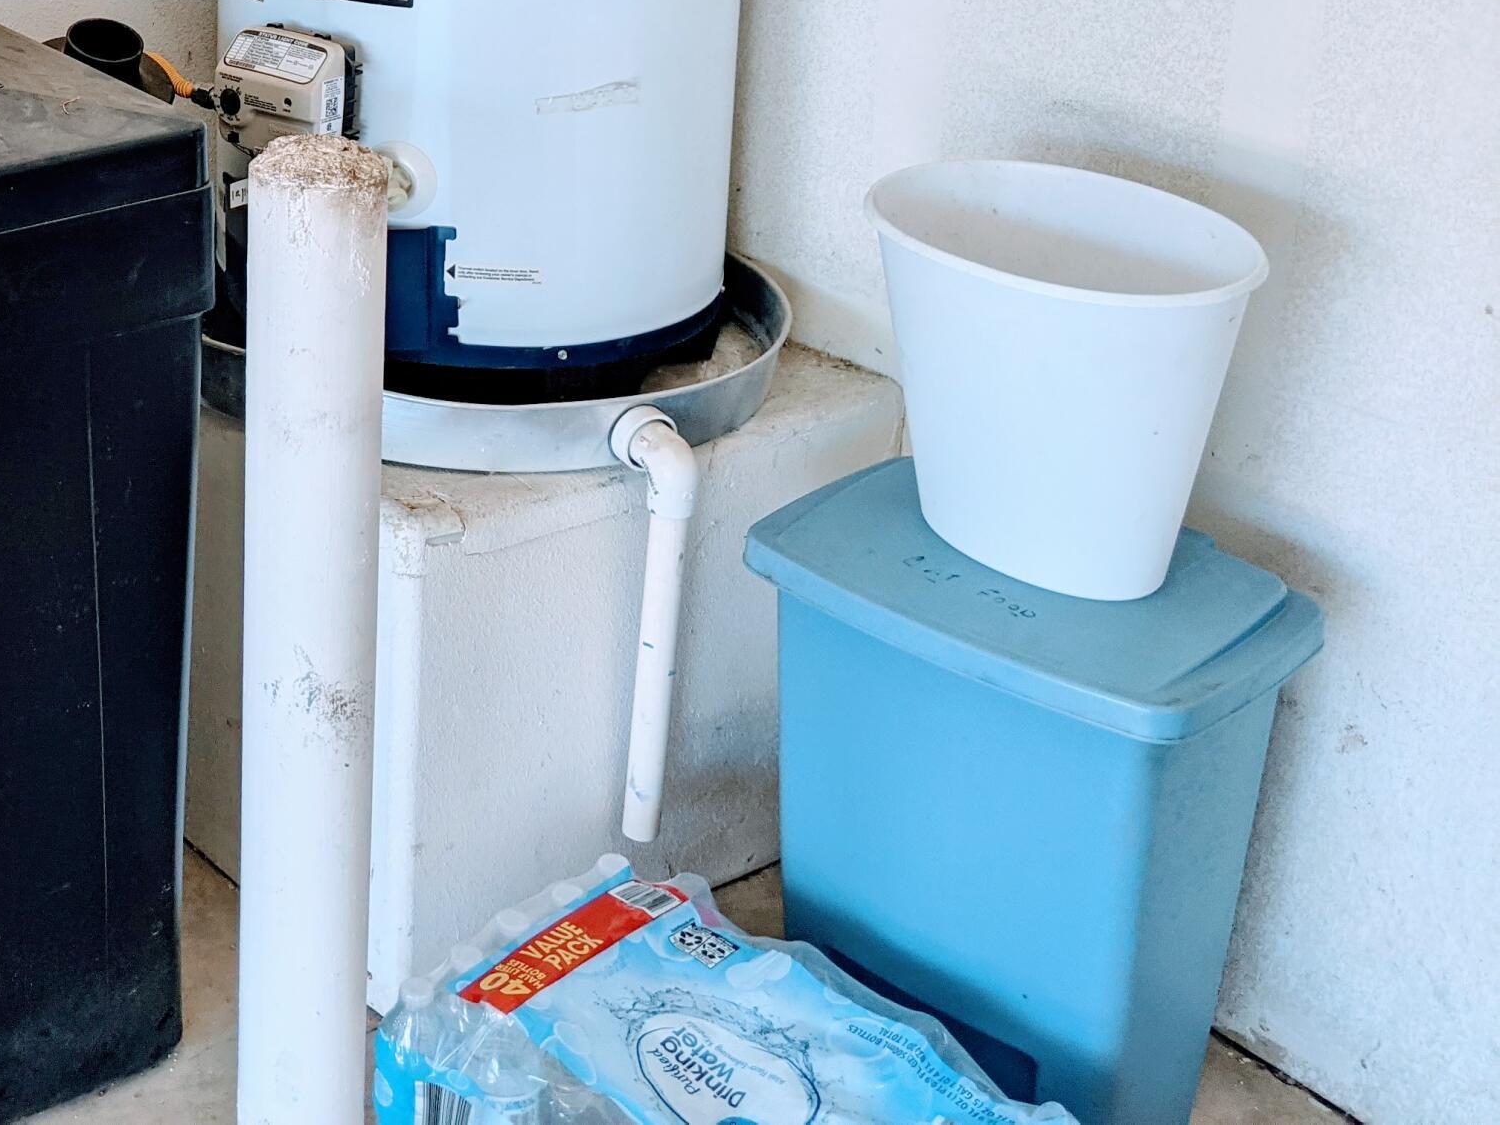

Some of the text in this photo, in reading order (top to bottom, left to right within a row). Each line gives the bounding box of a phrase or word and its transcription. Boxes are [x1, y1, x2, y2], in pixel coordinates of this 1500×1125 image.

[518, 921, 584, 959] VALUE
[542, 933, 605, 971] PACK
[479, 972, 532, 995] 40
[506, 958, 547, 981] BOTTLES
[518, 973, 545, 990] HALF
[646, 1047, 701, 1095] Purified
[659, 1036, 747, 1108] Drinking
[672, 1027, 735, 1083] Water
